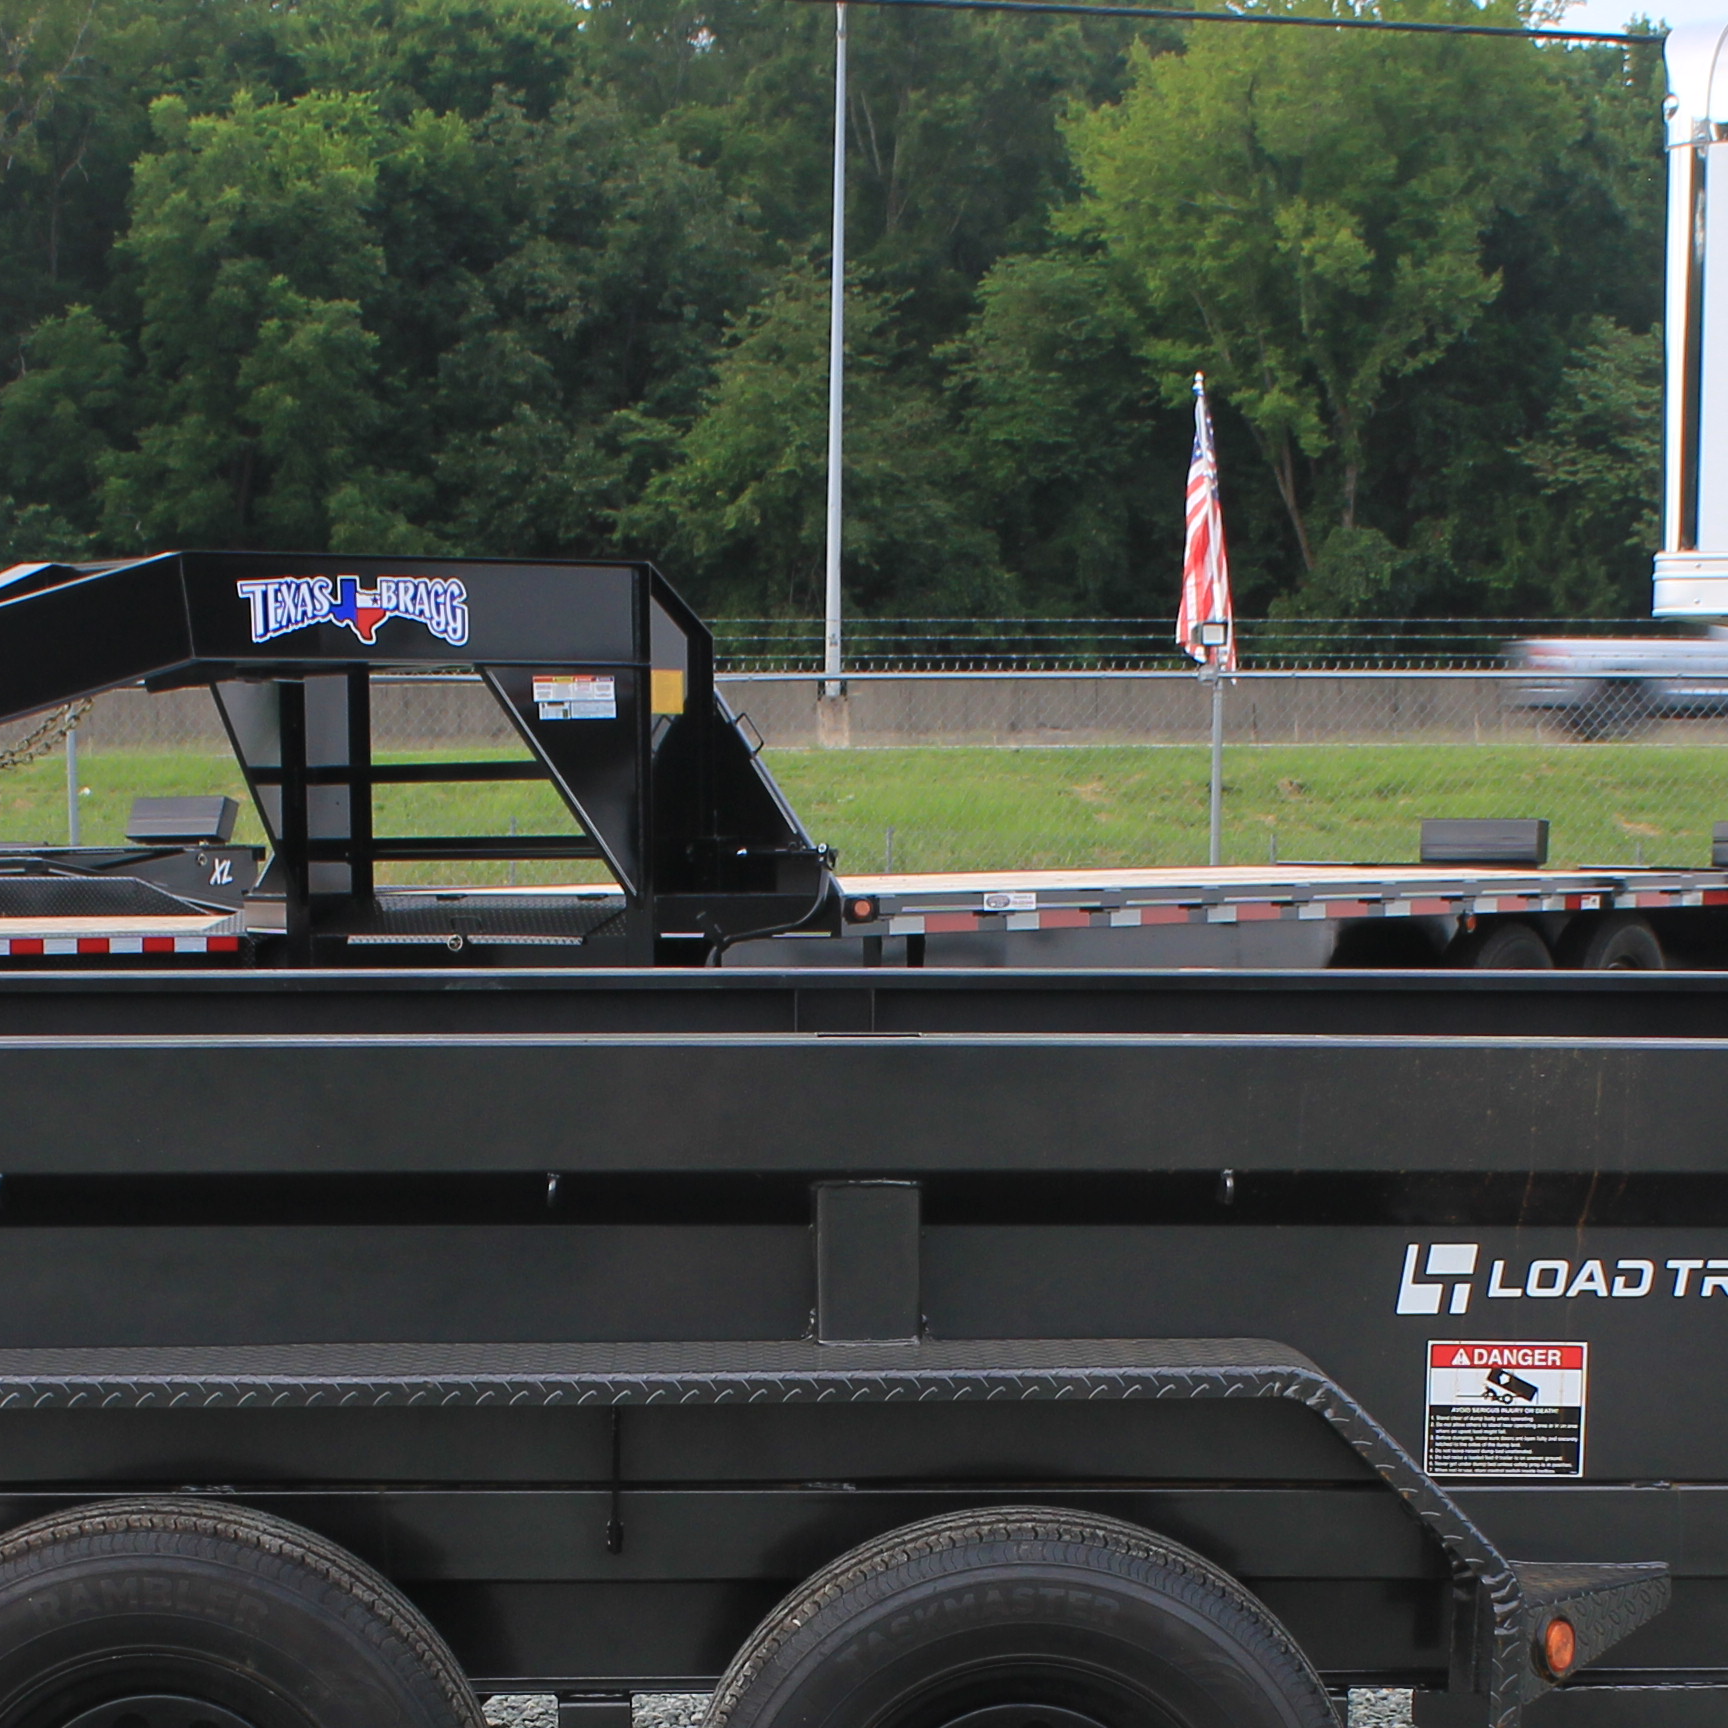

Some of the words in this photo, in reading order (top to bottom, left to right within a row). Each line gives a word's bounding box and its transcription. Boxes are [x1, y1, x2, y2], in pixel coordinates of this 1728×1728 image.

[239, 578, 332, 639] TEXAS
[379, 577, 467, 643] BRAGG
[209, 858, 233, 885] XL
[1487, 1259, 1655, 1298] LOAD
[1473, 1348, 1562, 1366] DANGER
[27, 1575, 270, 1630] RAMBLER
[834, 1585, 1122, 1668] TASKMASTER
